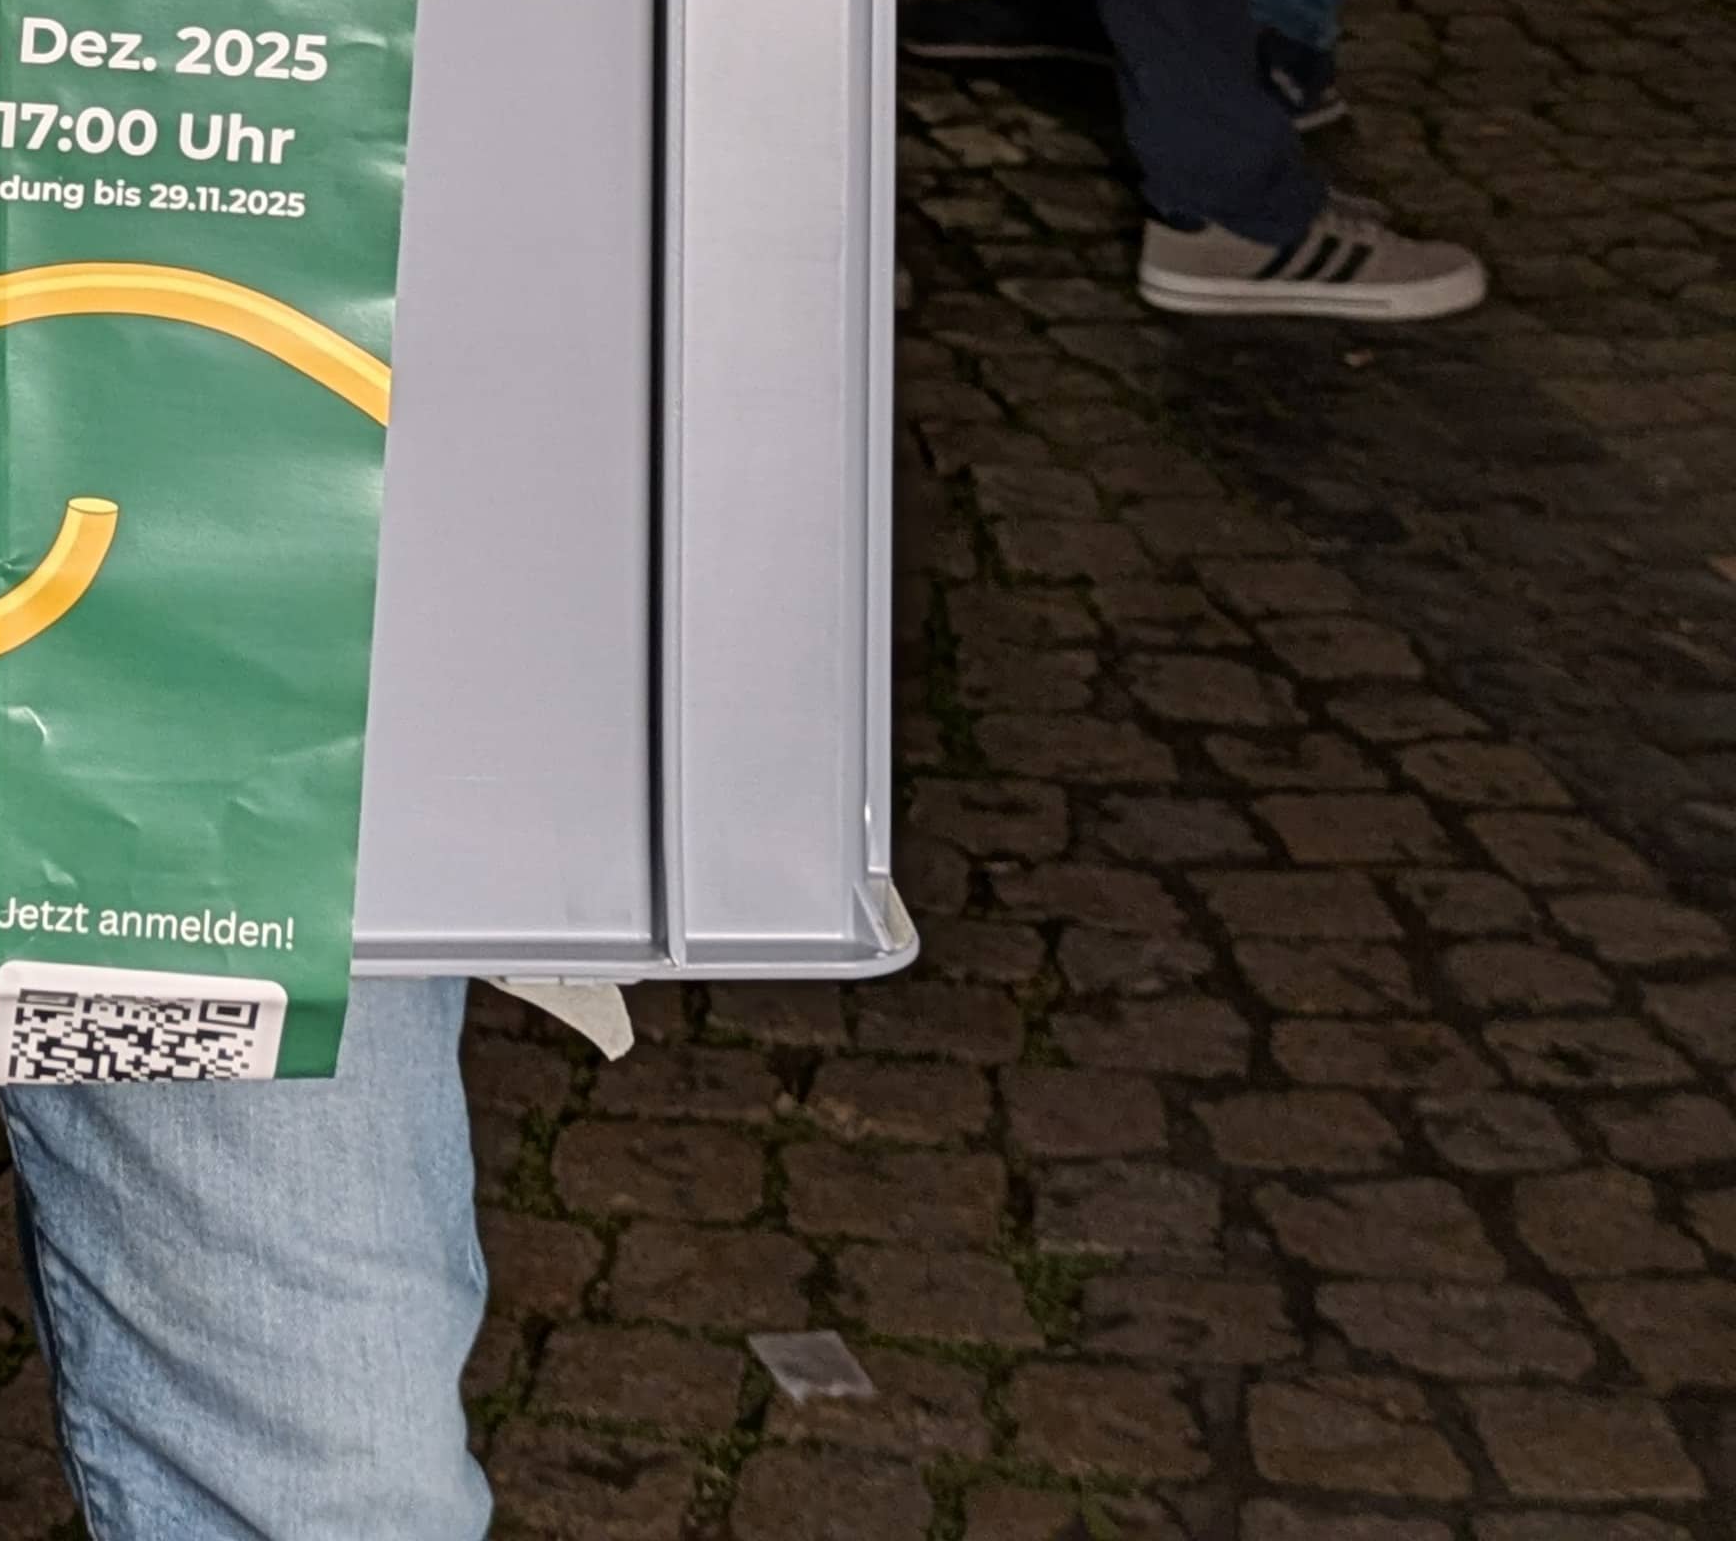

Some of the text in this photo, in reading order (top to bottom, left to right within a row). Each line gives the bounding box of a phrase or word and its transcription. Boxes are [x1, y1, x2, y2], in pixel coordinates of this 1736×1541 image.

[19, 16, 157, 72] Dez.
[175, 26, 328, 81] 2025
[178, 113, 296, 164] Uhr
[94, 179, 142, 207] bis
[149, 183, 306, 218] 29.11.2025
[99, 909, 294, 951] anmelden!
